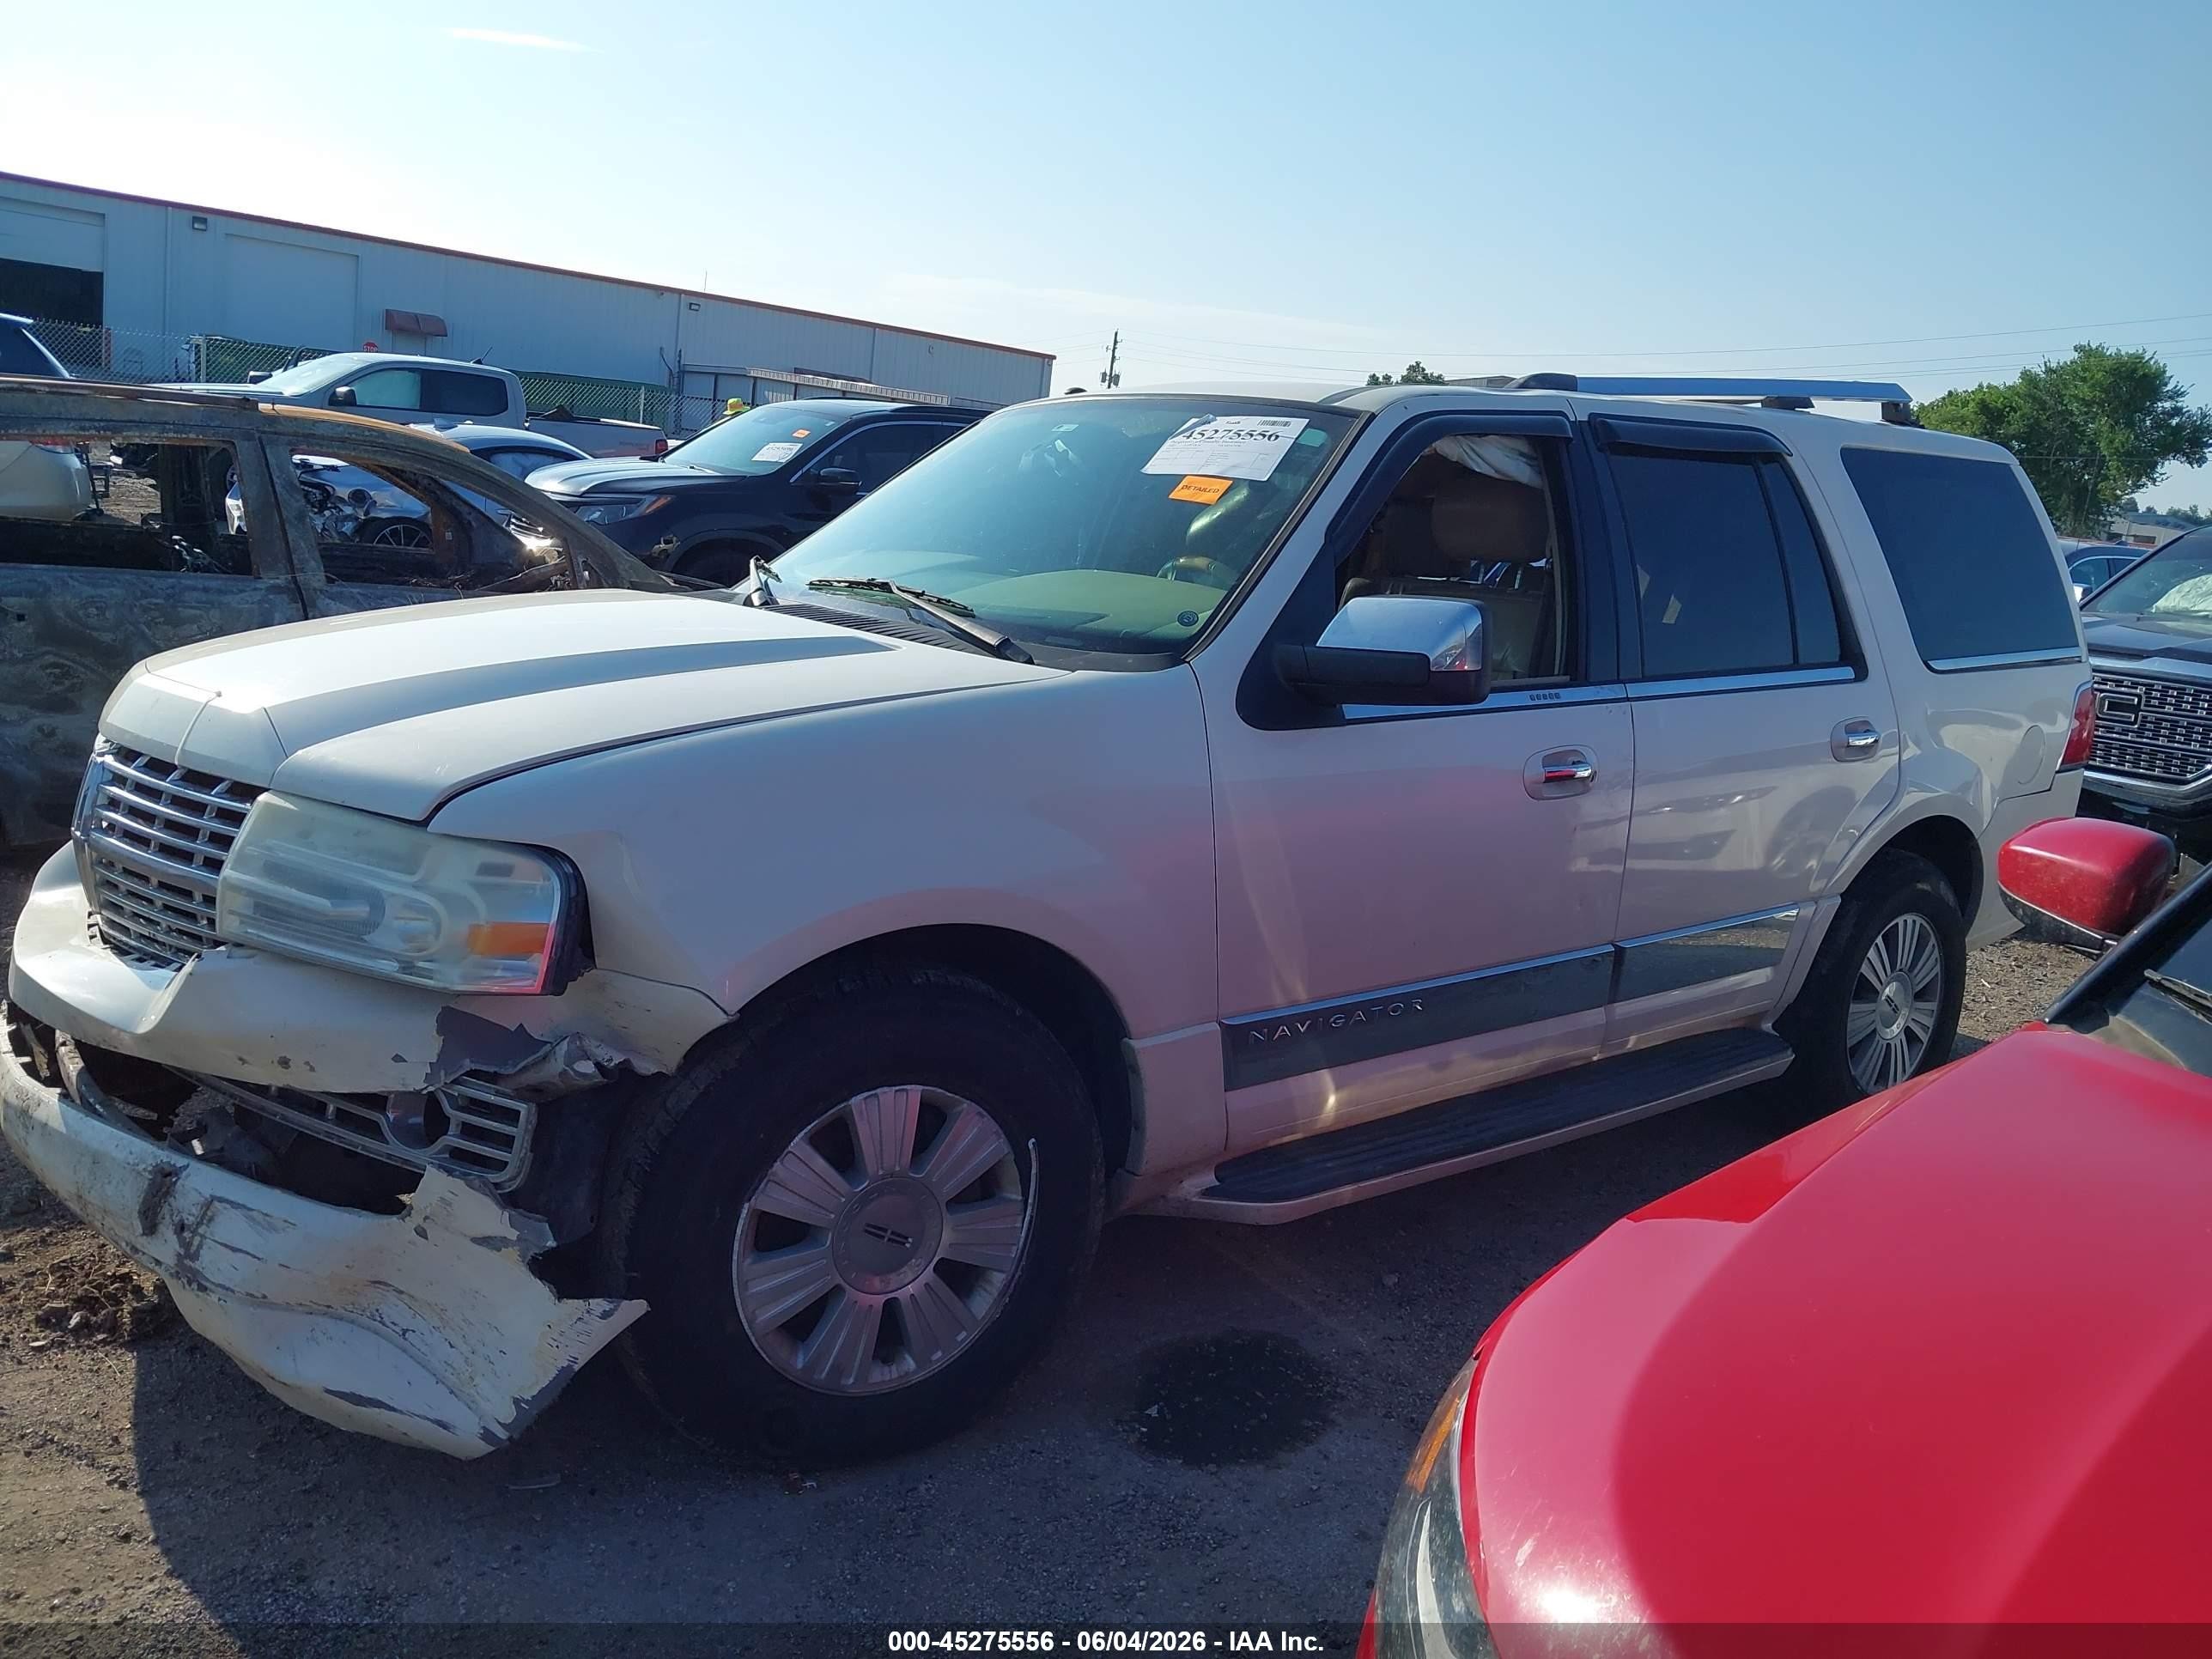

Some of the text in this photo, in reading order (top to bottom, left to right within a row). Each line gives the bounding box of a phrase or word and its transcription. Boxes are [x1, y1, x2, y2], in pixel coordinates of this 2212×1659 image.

[1182, 428, 1284, 441] 45275556
[1181, 484, 1220, 494] DETAILED
[1249, 999, 1424, 1044] NAVIGATOR
